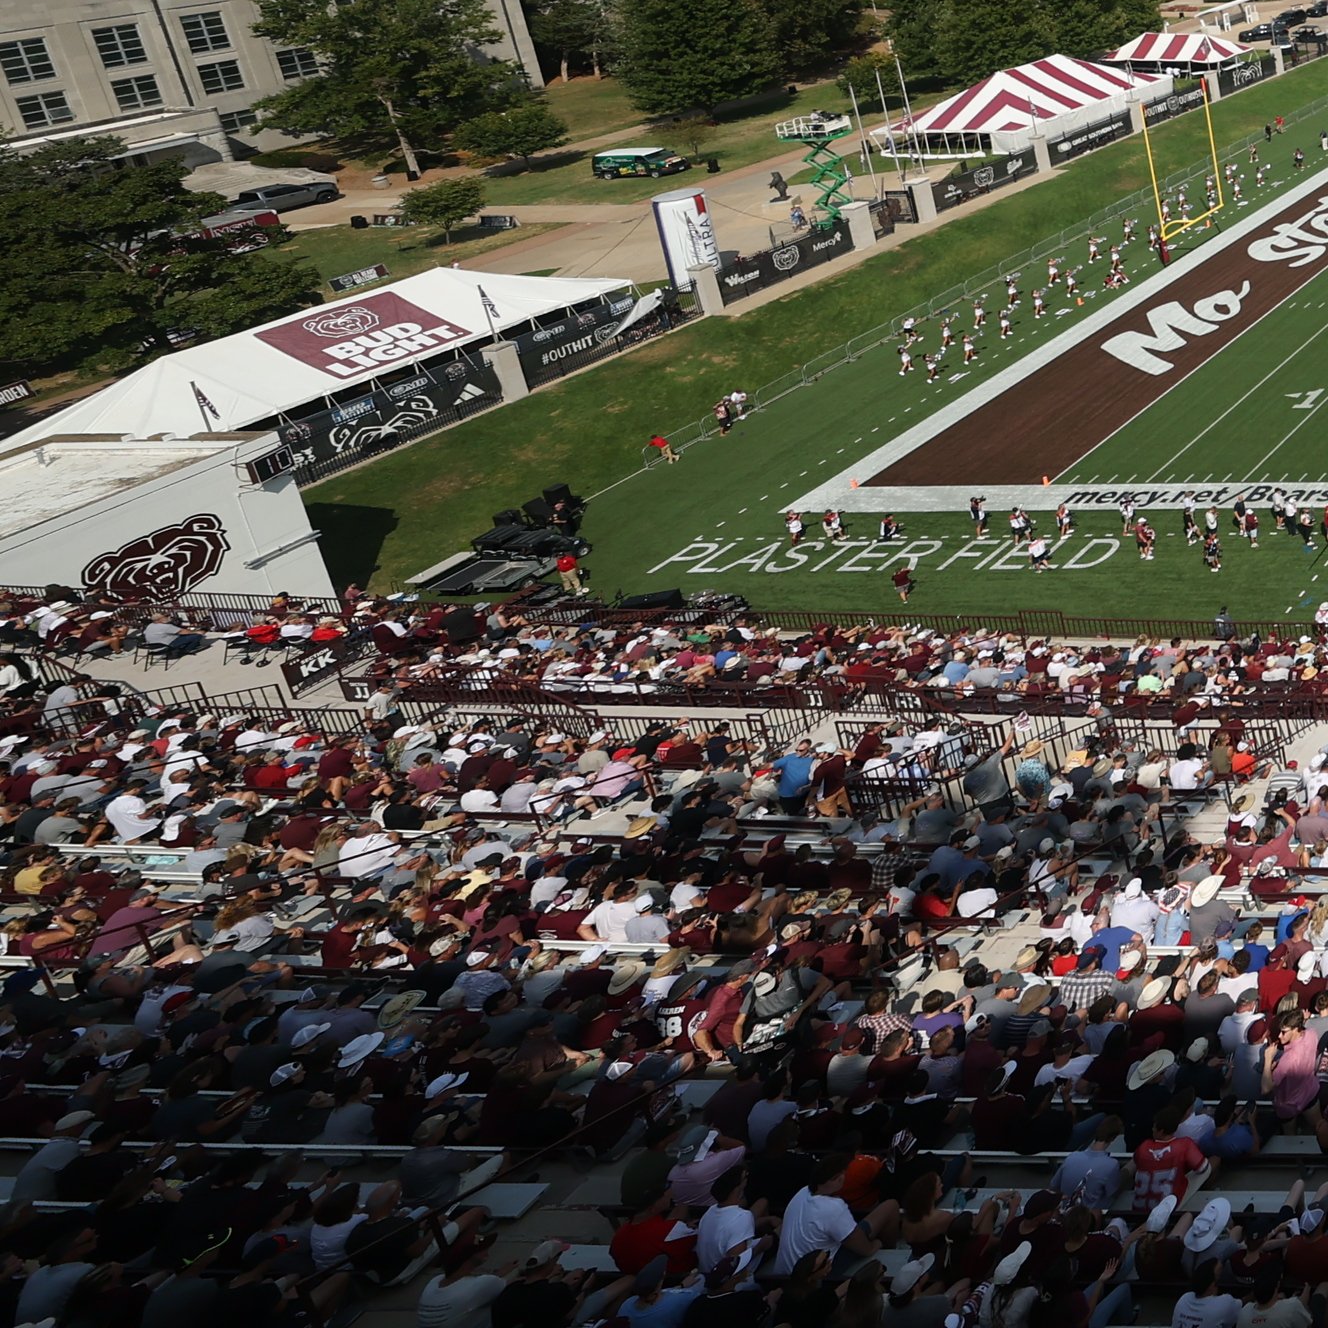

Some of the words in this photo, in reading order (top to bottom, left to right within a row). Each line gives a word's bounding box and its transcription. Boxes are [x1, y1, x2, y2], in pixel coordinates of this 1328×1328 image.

[1072, 135, 1088, 147] GREAT
[1088, 127, 1111, 142] SOUTHERN
[1111, 121, 1124, 133] BANK
[700, 218, 720, 268] ULTRA
[812, 235, 837, 252] Mercy
[322, 322, 423, 360] BUD
[1100, 279, 1253, 377] Mo
[325, 325, 464, 376] LIGHT.
[541, 334, 593, 366] #OUTHIT
[647, 539, 940, 574] PLASTER
[300, 650, 337, 678] KK
[354, 687, 370, 699] JJ
[808, 694, 823, 707] JJ
[1134, 1167, 1179, 1196] 25
